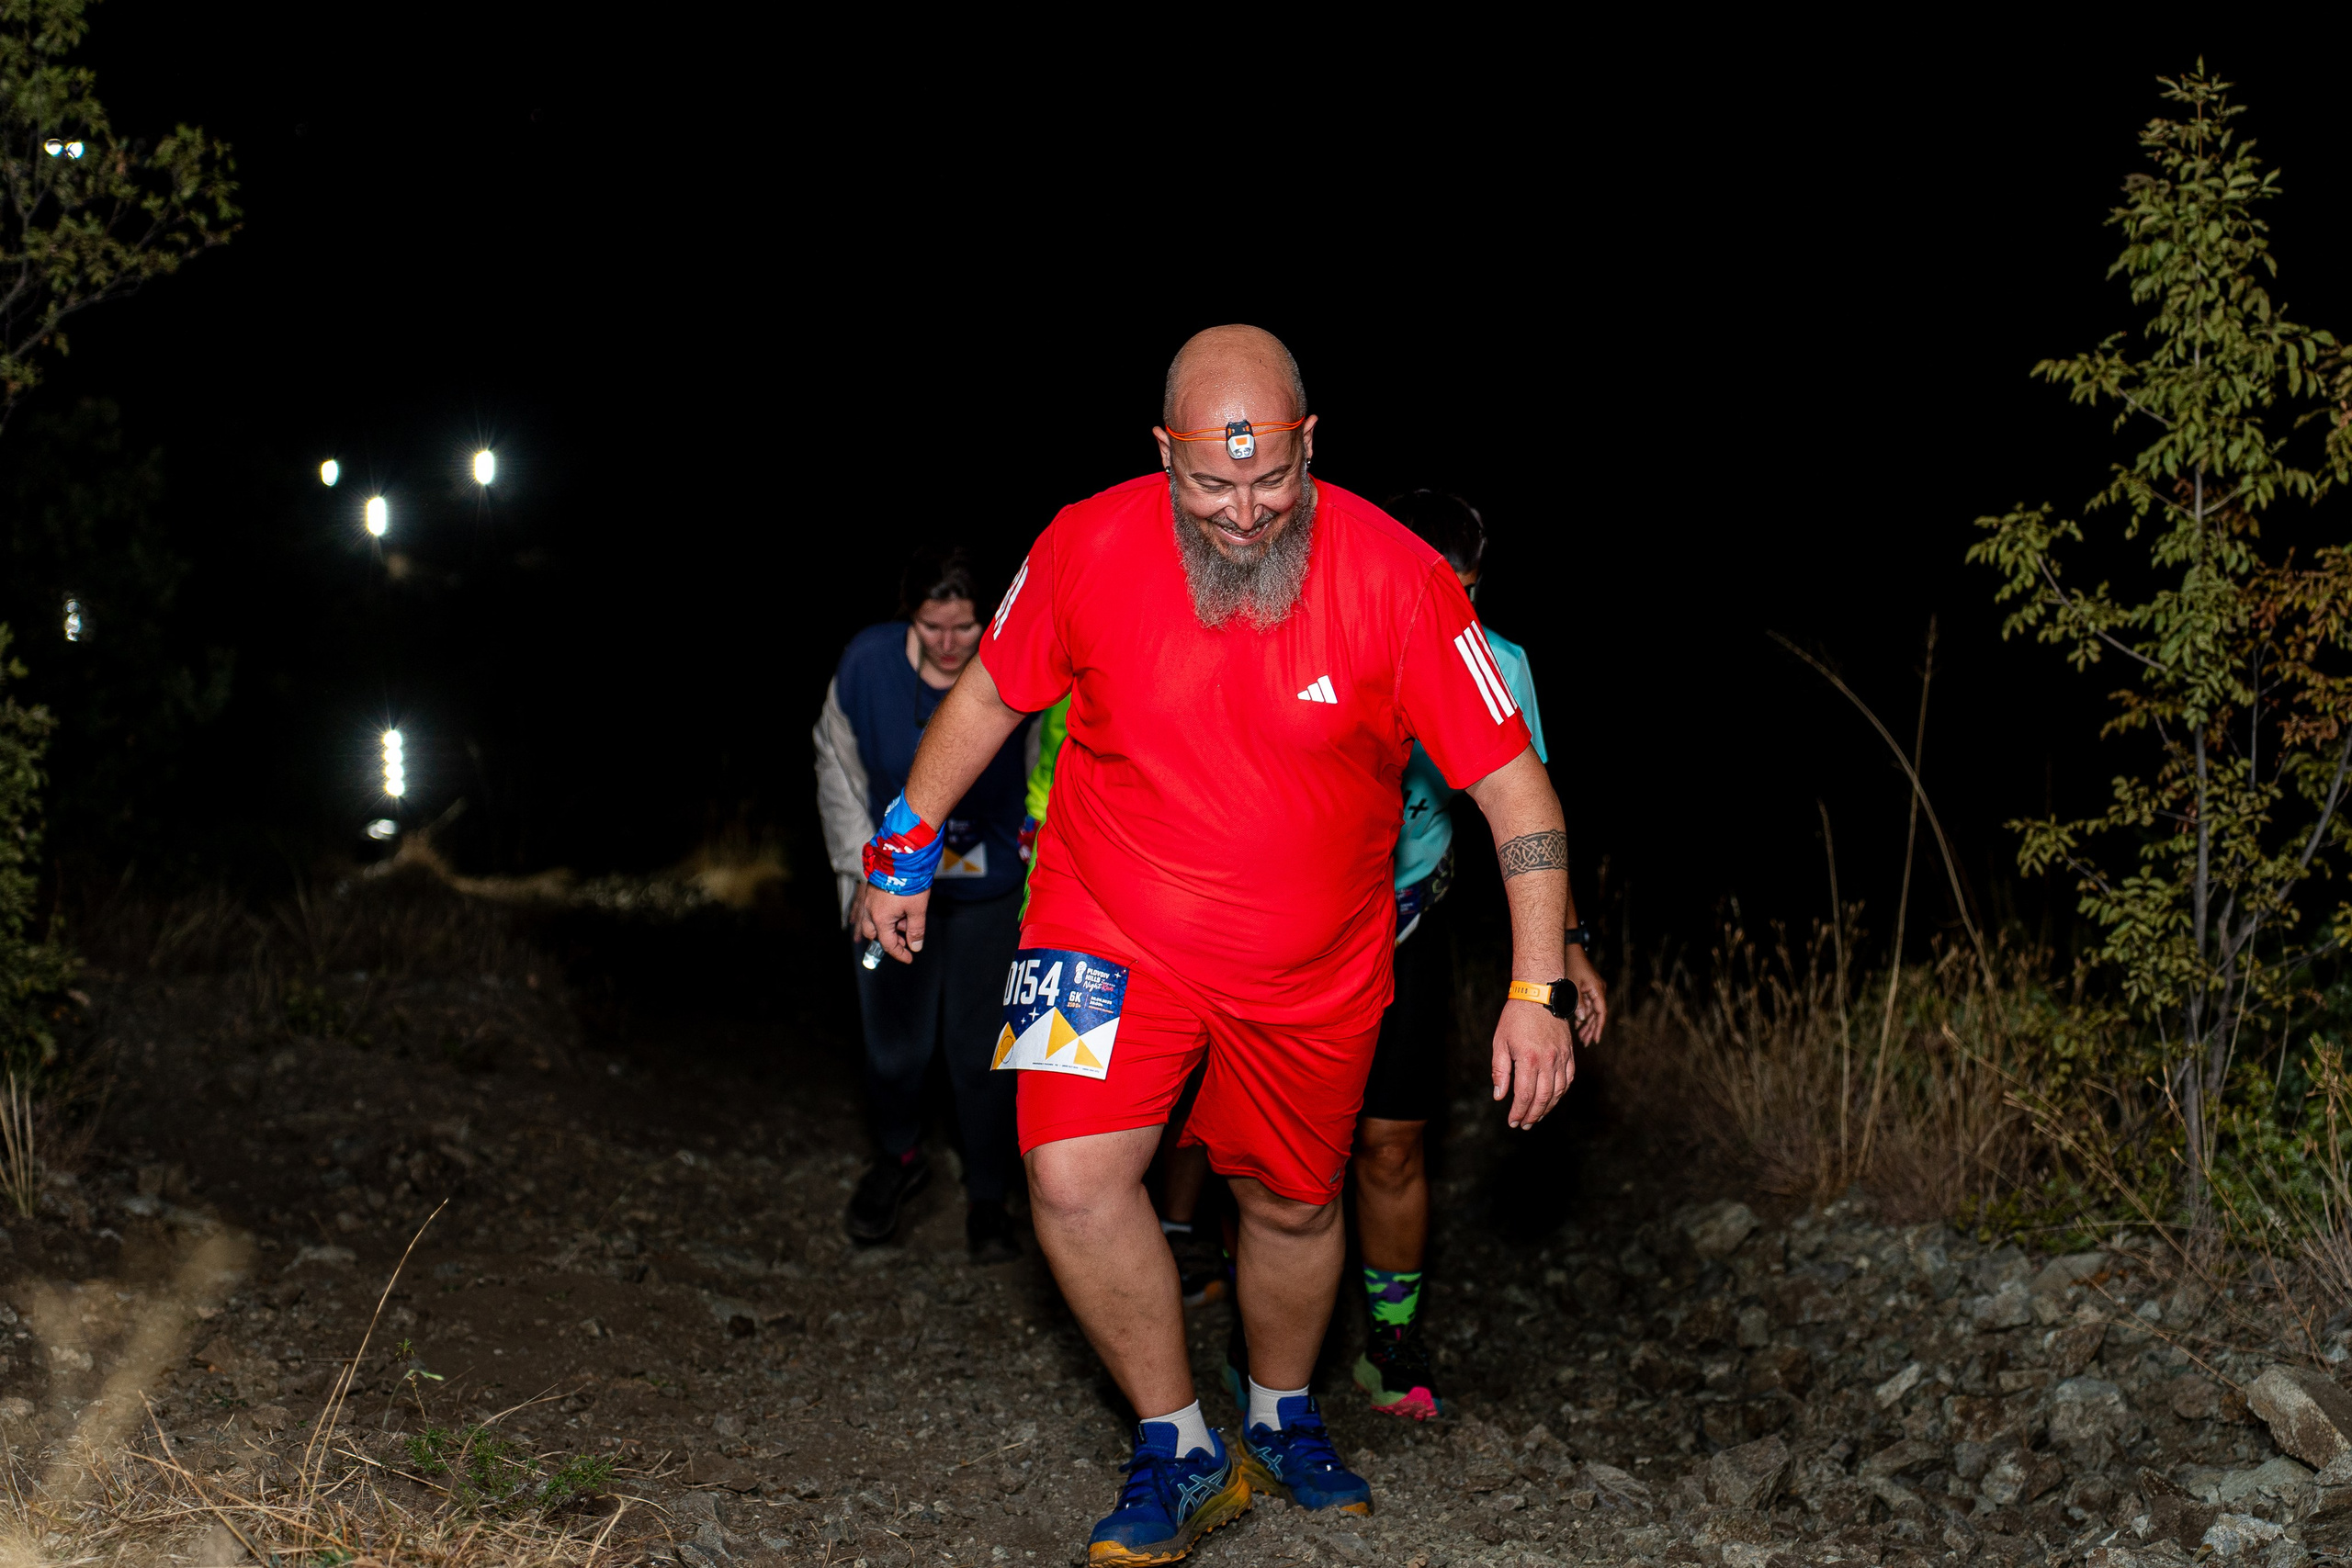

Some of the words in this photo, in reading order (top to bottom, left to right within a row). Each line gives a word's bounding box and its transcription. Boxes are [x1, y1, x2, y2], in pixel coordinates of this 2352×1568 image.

[1085, 974, 1101, 983] HILLS
[1087, 968, 1110, 979] PLOVDIV
[1003, 959, 1063, 1006] 0154
[1083, 980, 1102, 992] Night
[1069, 991, 1082, 1002] 6K
